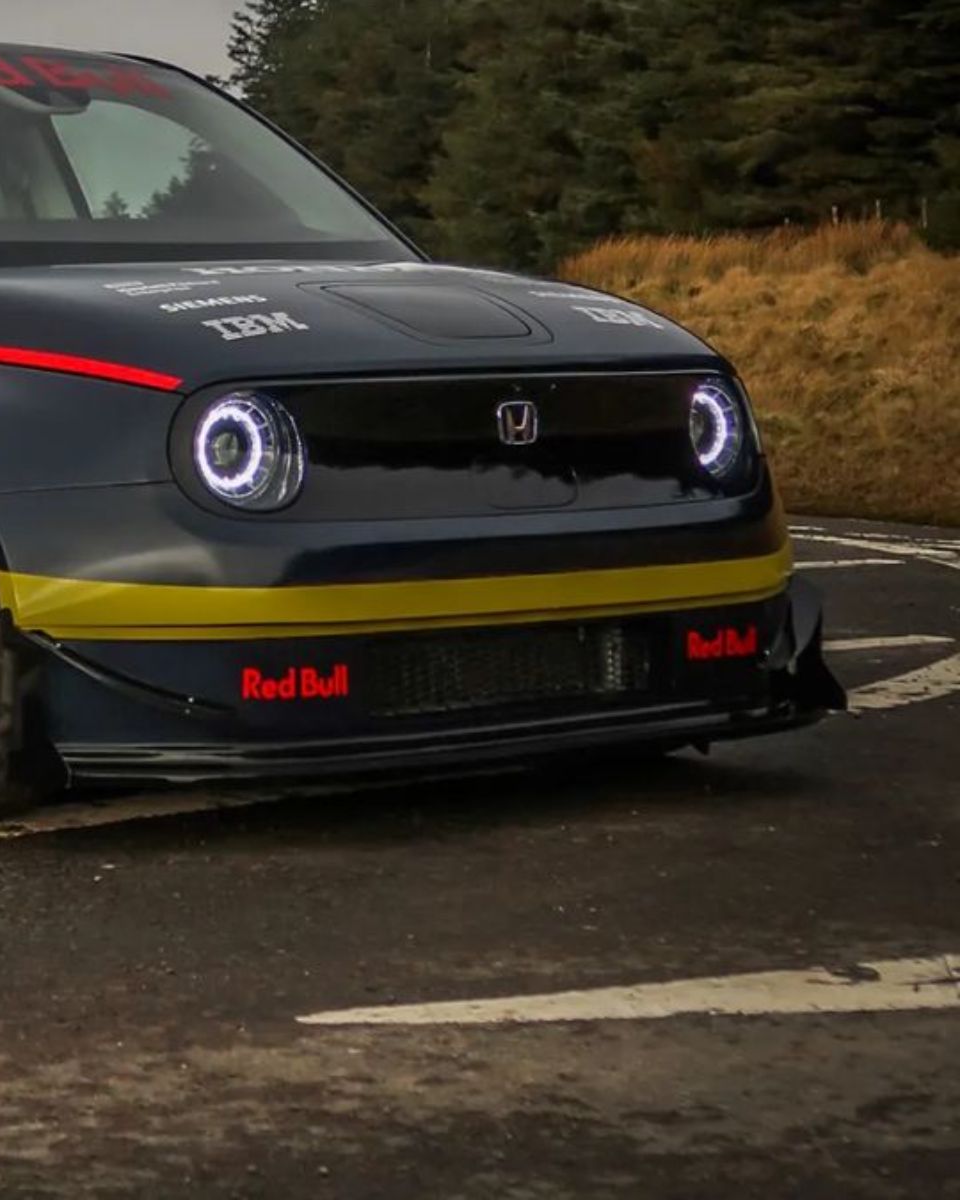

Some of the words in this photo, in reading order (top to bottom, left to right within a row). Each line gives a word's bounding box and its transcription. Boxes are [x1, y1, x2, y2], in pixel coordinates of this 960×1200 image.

[200, 311, 310, 341] IBM
[687, 629, 723, 659] Red
[242, 666, 297, 699] Red
[301, 663, 348, 698] Bull
